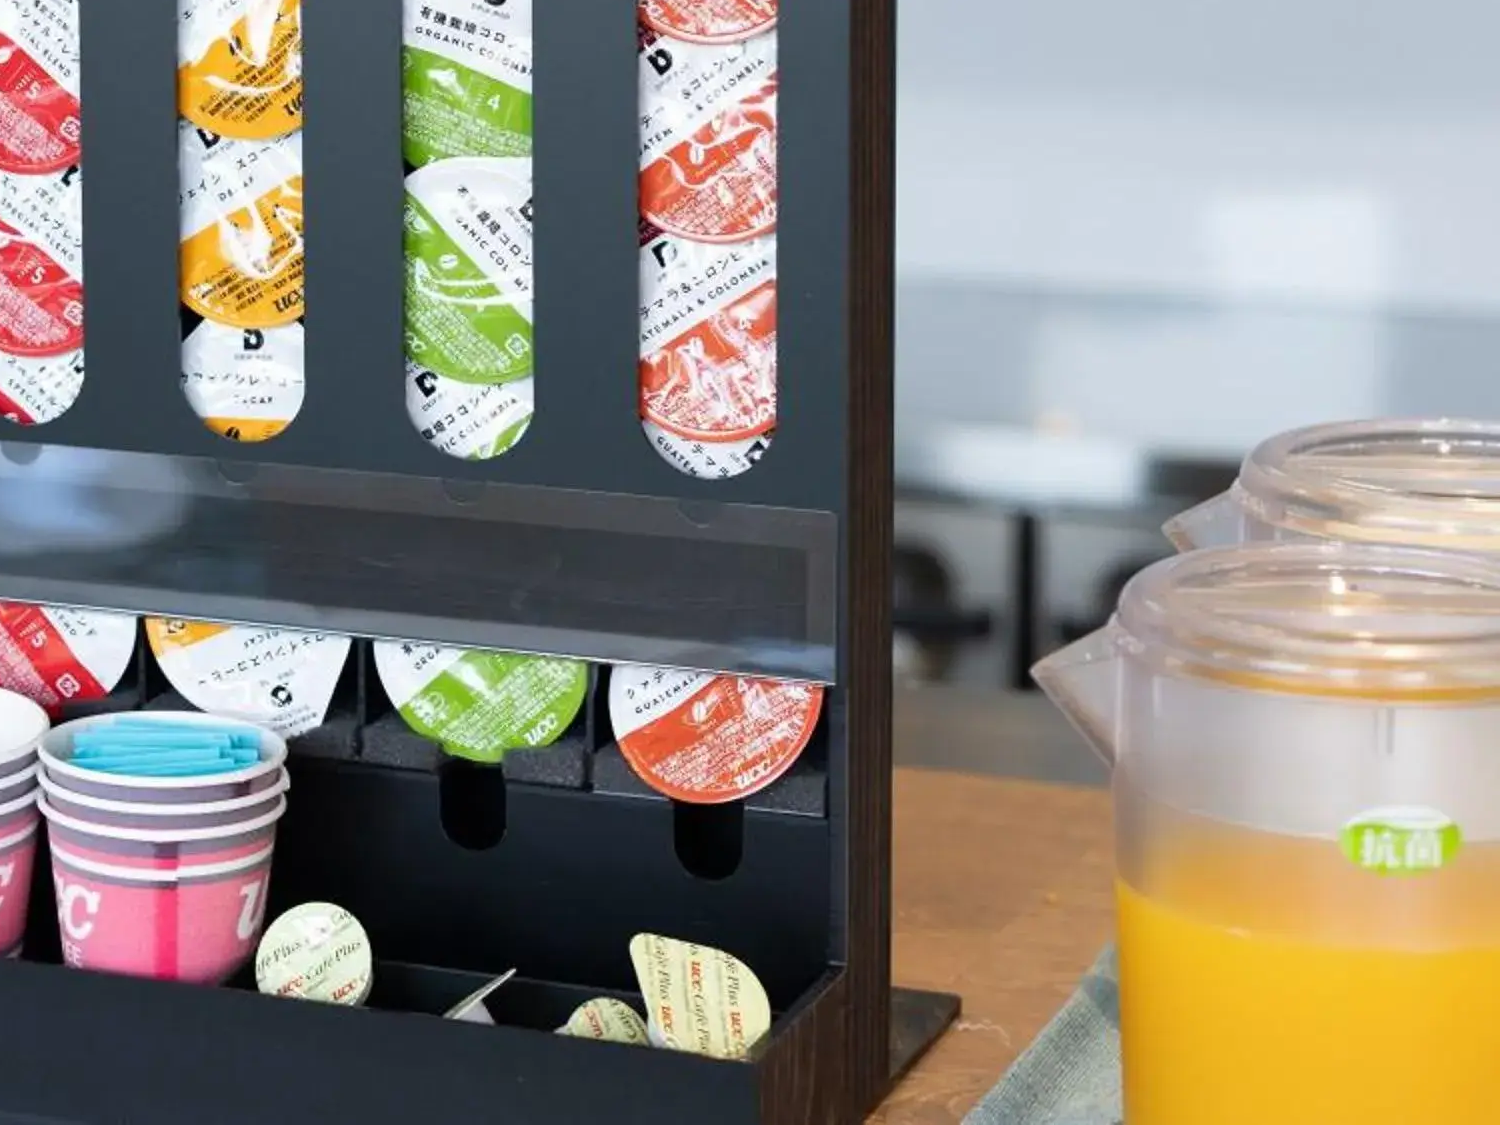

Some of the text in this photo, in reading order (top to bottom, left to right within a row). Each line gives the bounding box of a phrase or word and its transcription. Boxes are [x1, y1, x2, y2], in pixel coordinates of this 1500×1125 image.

[415, 25, 475, 53] ORGANIC
[708, 259, 770, 300] COLOMBIA
[32, 634, 46, 649] 5
